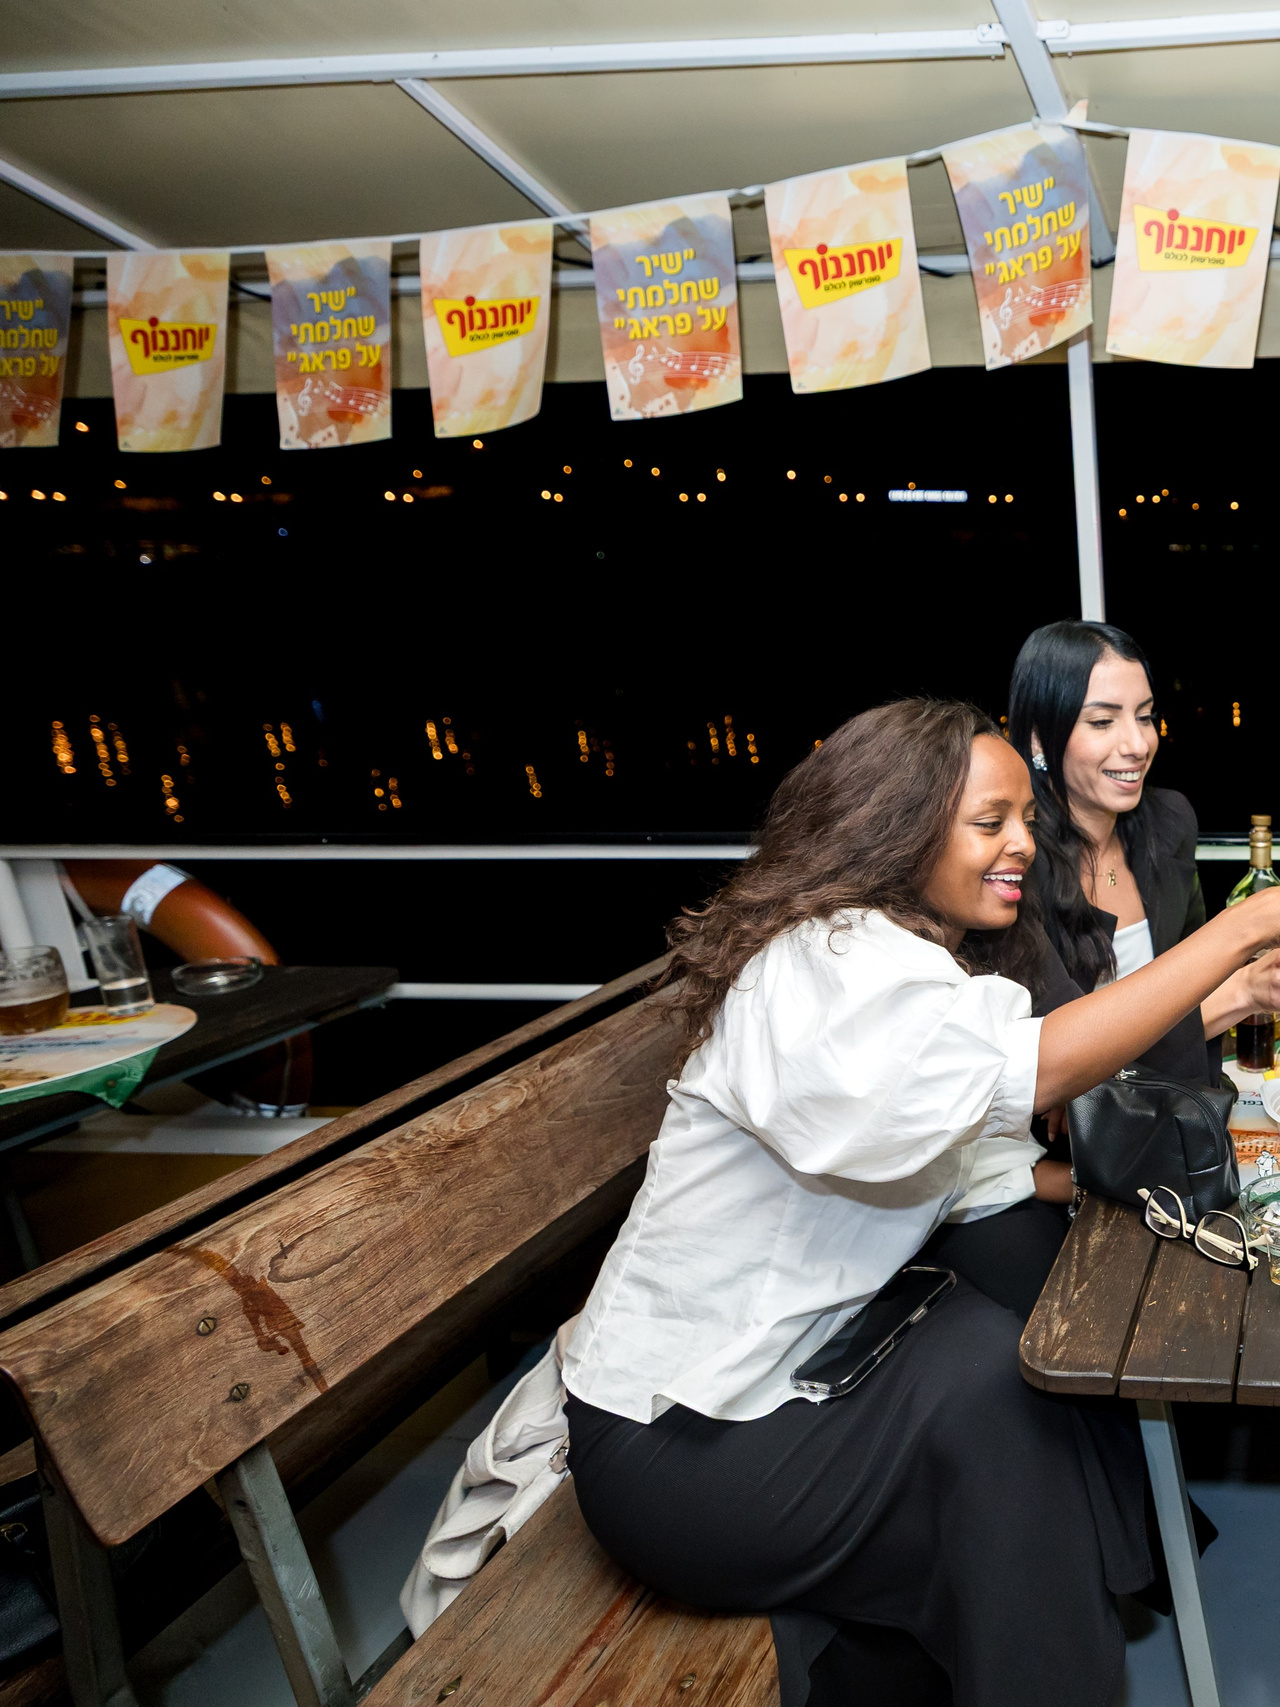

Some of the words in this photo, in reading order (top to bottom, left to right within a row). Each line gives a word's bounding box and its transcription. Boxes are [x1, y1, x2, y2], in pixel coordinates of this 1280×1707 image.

[984, 201, 1075, 252] שחלמתי
[1056, 229, 1081, 260] על
[616, 277, 719, 309] שחלמתי
[290, 315, 376, 344] שחלמתי
[697, 305, 727, 331] על
[0, 325, 58, 348] שחלמ
[40, 352, 59, 377] על
[356, 342, 381, 367] על
